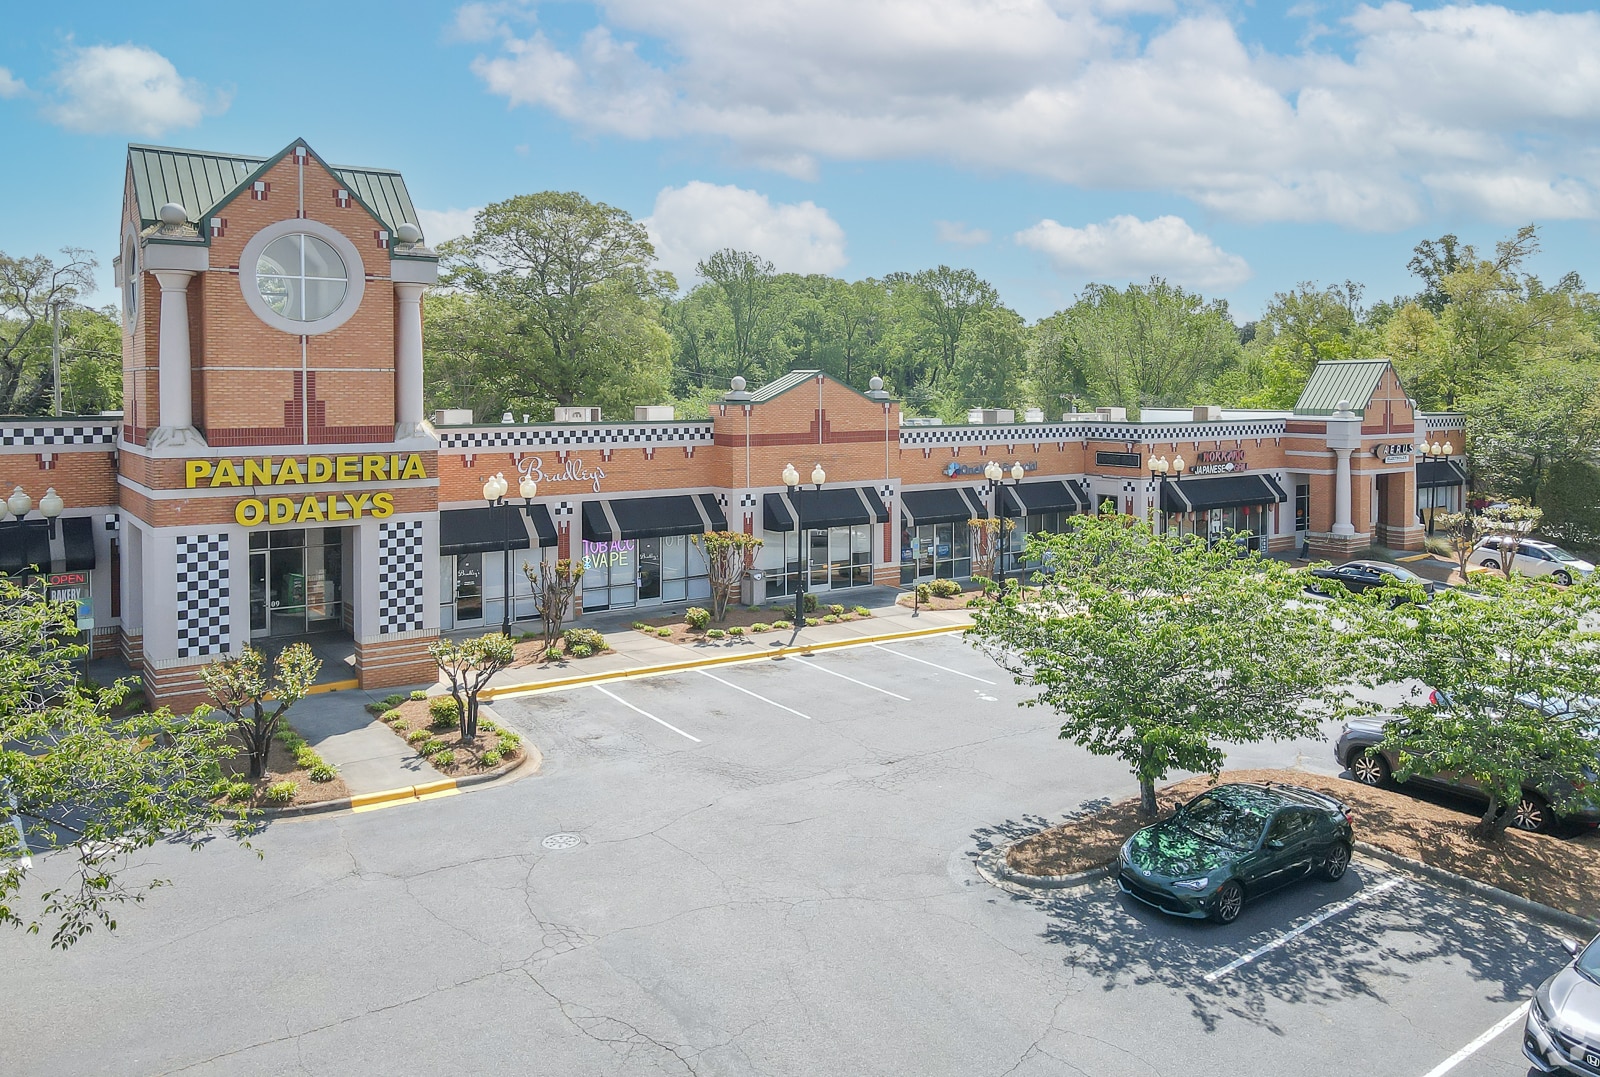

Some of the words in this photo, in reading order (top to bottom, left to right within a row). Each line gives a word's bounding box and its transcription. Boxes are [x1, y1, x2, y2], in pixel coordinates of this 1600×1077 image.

[1383, 444, 1414, 454] AERUS
[185, 454, 427, 488] PANADERIA
[1195, 464, 1226, 474] JAPANESE
[234, 493, 395, 527] ODALYS
[591, 551, 629, 568] VAPE
[51, 574, 84, 585] OPEN
[51, 587, 81, 603] BAKERY
